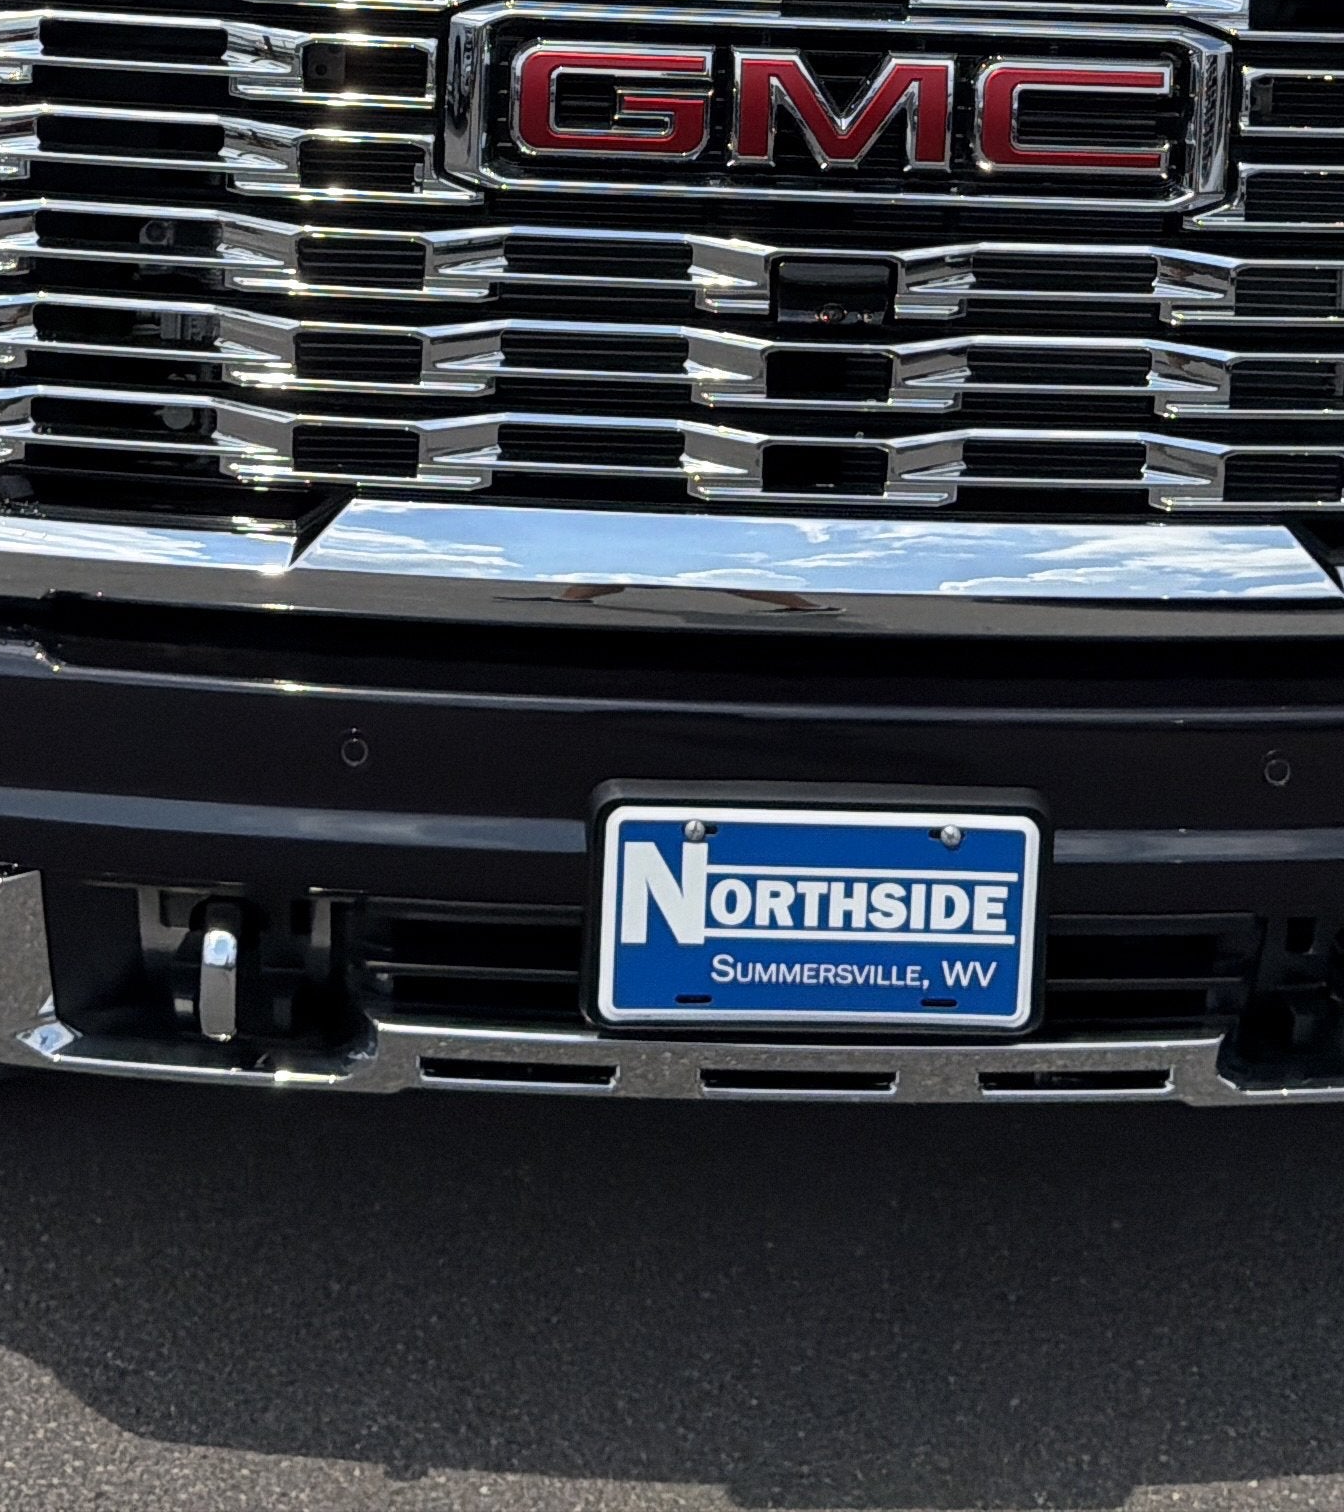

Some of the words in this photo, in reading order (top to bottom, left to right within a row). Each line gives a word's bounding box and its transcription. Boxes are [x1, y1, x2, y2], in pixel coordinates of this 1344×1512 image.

[511, 39, 1174, 179] GMC
[621, 841, 1009, 945] NORTHSIDE
[711, 953, 930, 989] SUMMERSVILLE,
[942, 959, 998, 988] WV
